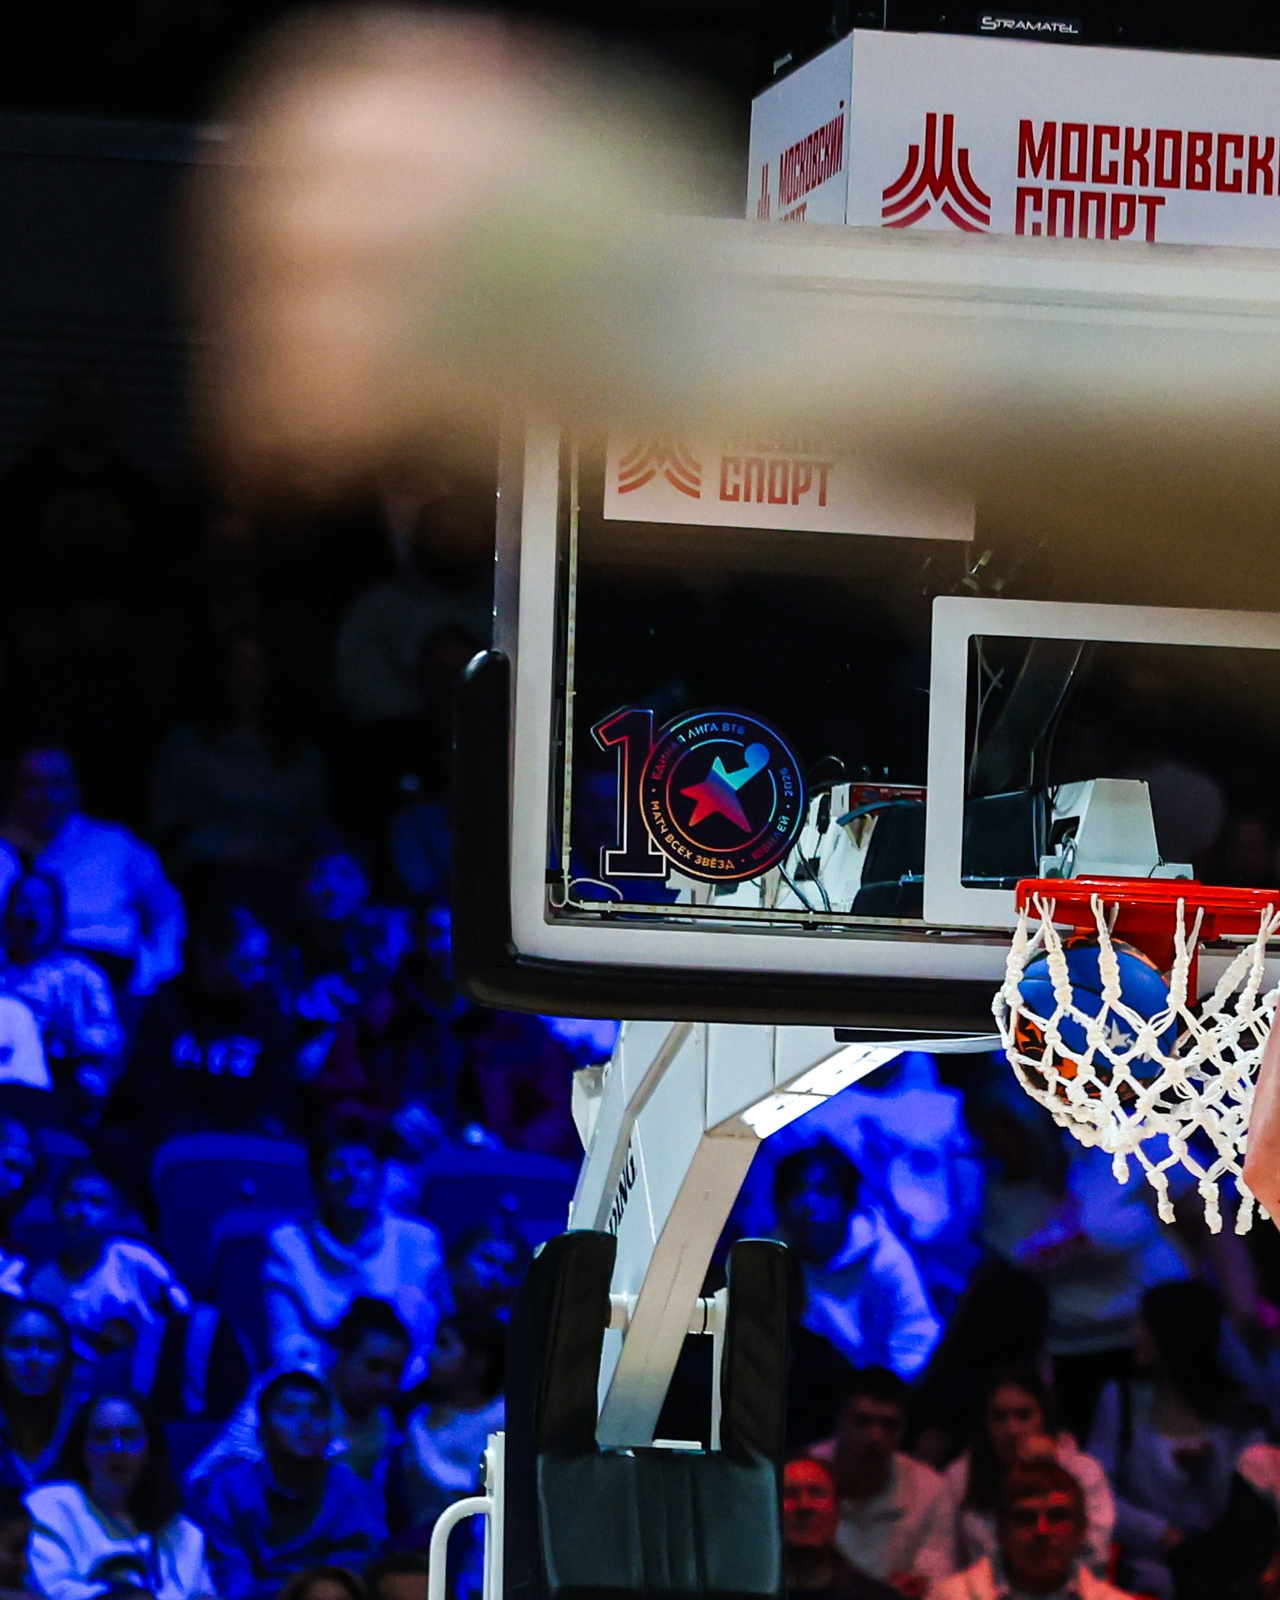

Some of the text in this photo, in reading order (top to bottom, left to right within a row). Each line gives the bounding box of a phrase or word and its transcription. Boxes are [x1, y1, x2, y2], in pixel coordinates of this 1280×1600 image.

[980, 15, 1079, 34] STRAMATEL
[1015, 186, 1167, 243] СПОРТ
[718, 455, 835, 507] СПОРТ
[687, 721, 720, 741] ЛИГА
[649, 800, 736, 871] МАТЧ ВСЕХ ЗВЁЗД
